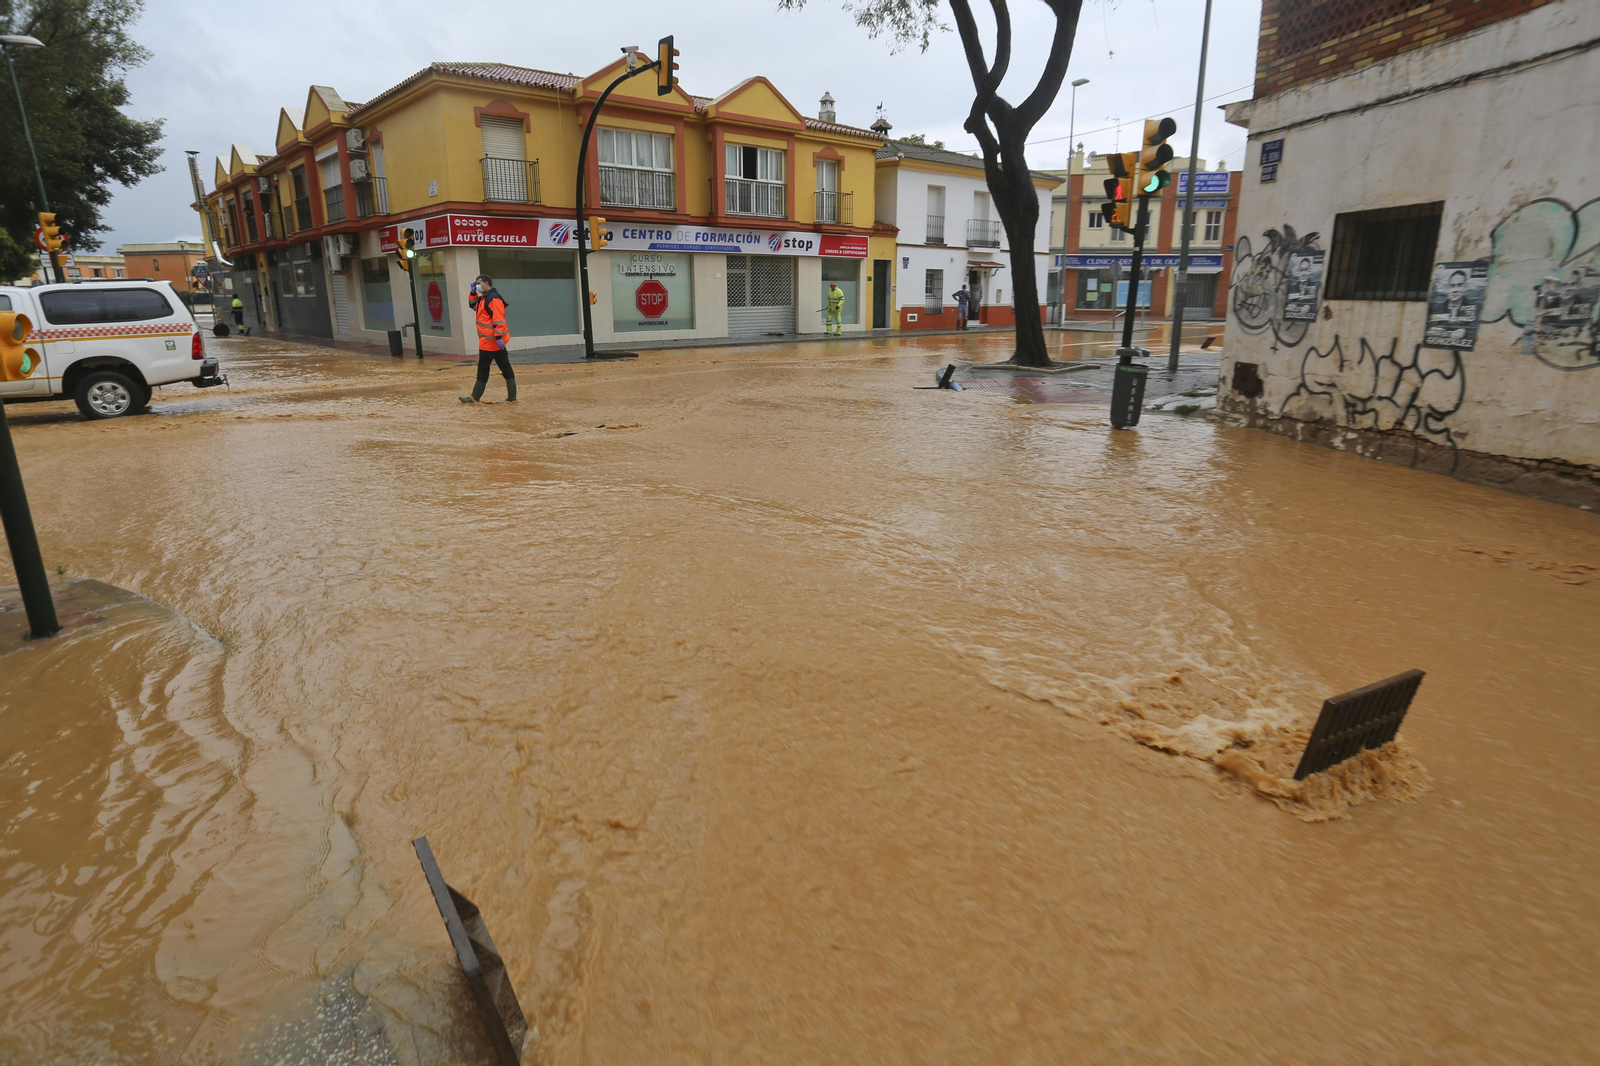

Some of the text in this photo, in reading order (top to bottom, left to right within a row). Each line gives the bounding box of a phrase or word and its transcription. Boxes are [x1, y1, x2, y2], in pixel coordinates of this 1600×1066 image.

[456, 234, 527, 243] AUTOESCUELA
[622, 228, 761, 244] CENTRO DE FORMACIÓN
[783, 238, 813, 251] stop
[632, 254, 662, 262] CURSO
[621, 264, 675, 272] INTENSIVO
